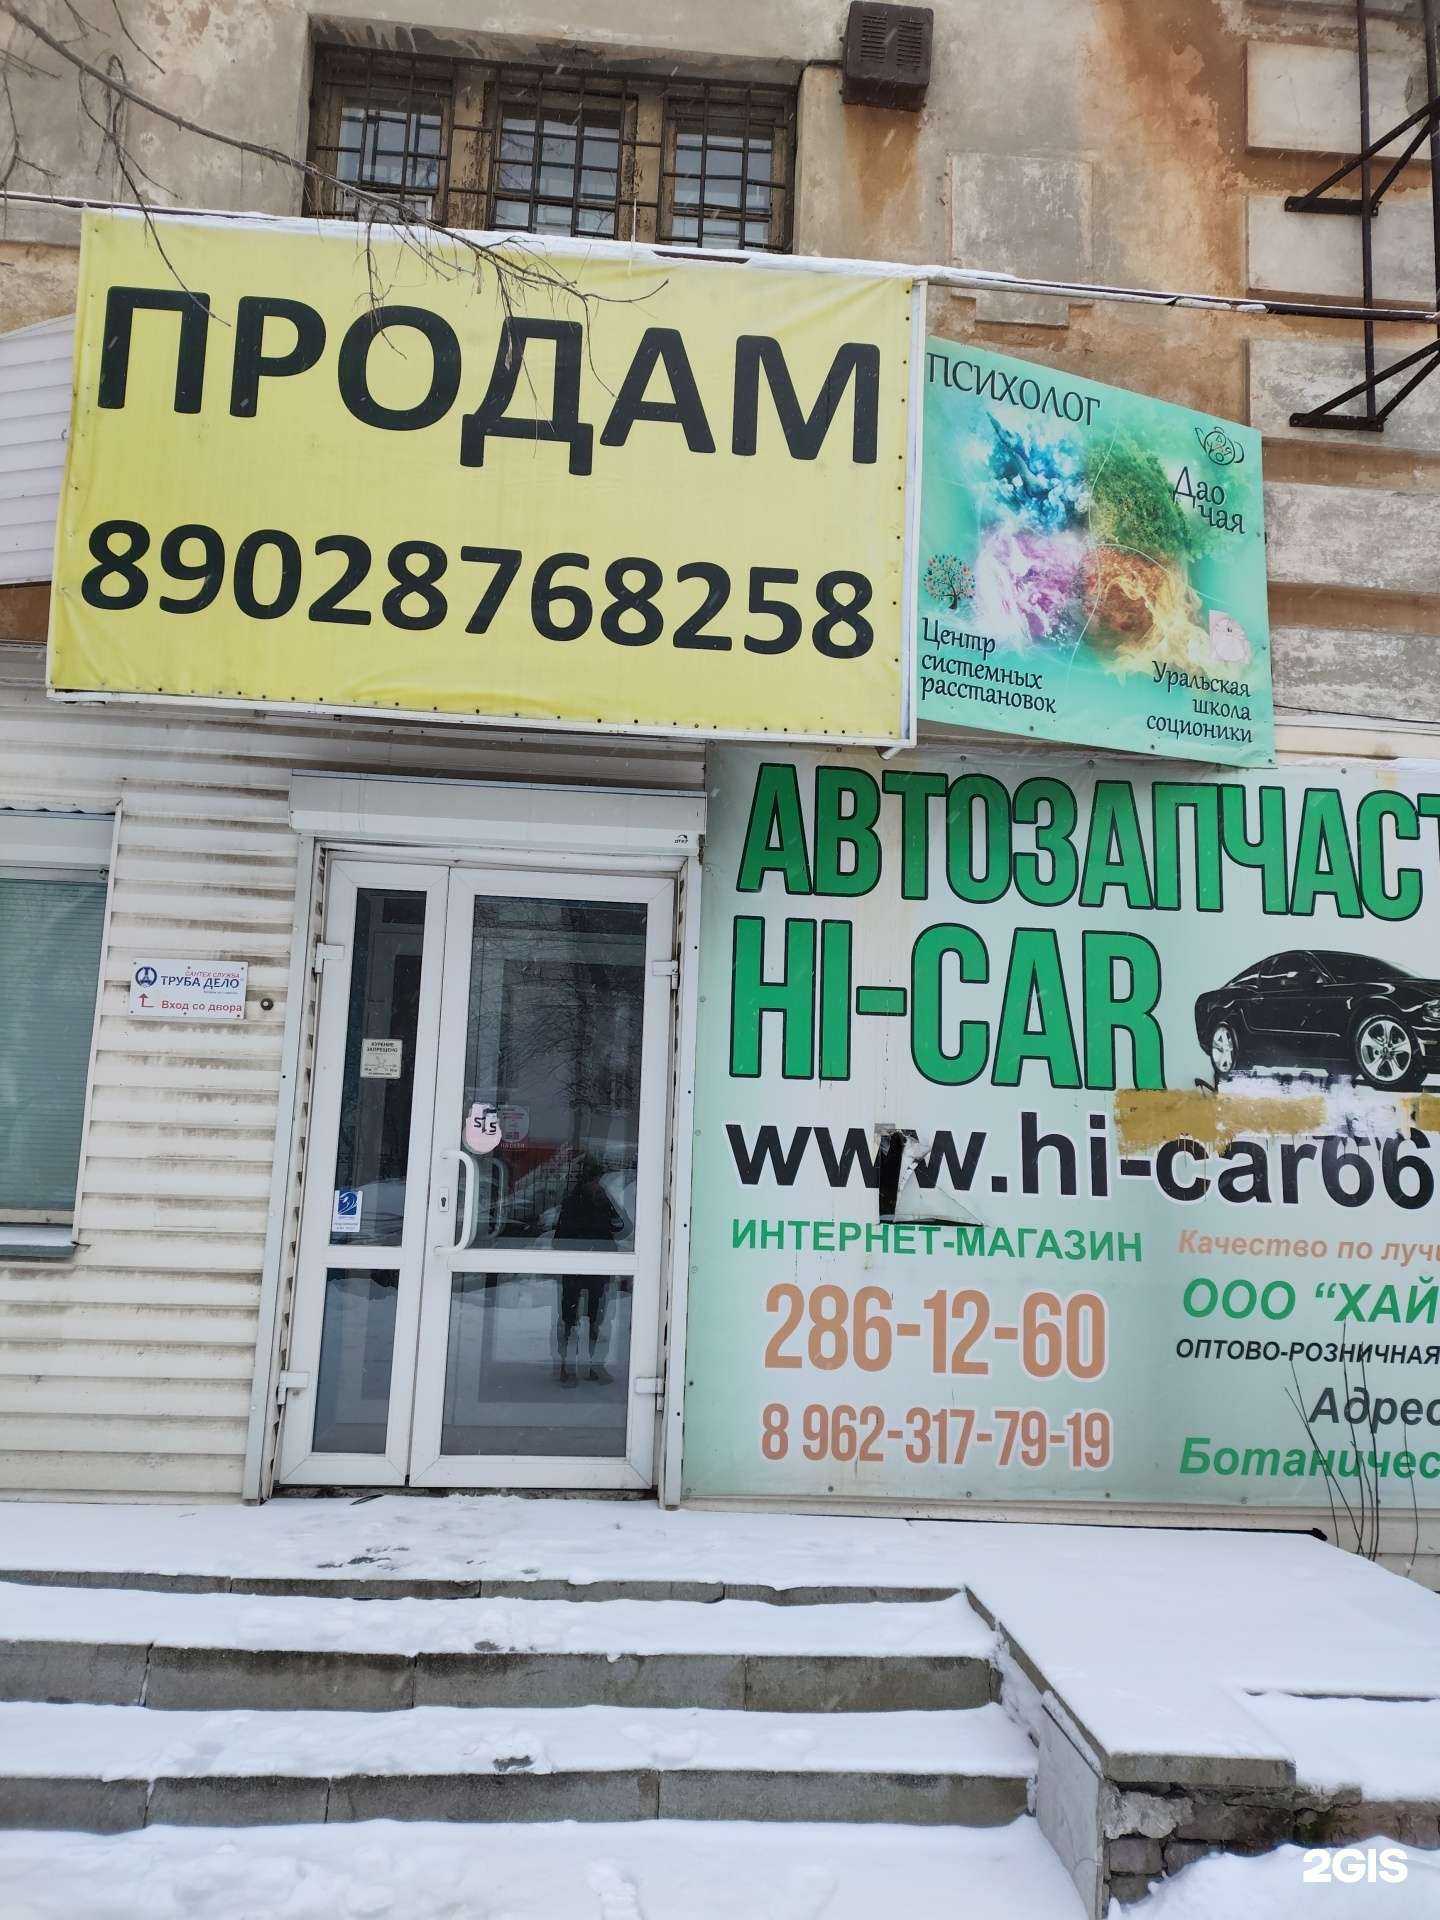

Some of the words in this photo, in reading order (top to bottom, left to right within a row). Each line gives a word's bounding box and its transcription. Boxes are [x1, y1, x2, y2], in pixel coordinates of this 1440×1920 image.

[97, 286, 880, 476] ПРОДАМ
[927, 352, 1100, 425] ПСИХОЛОГ
[1173, 465, 1225, 508] Дао
[1199, 504, 1247, 534] чая
[80, 519, 874, 659] 89028768258
[921, 617, 997, 661] Центр
[920, 675, 1057, 714] расстановок
[921, 656, 1043, 690] системных
[1151, 660, 1250, 698] Уральская
[1146, 715, 1253, 743] соционики
[1193, 698, 1252, 721] школа
[161, 975, 201, 987] ТРУБА
[203, 978, 240, 990] ДЕЛО
[728, 915, 1166, 1091] HI-CAR
[161, 1000, 189, 1011] Вход
[192, 1003, 206, 1011] со
[208, 1003, 242, 1013] двора
[731, 1218, 1143, 1263] ИНТЕРНЕТ-МАГАЗИН
[1178, 1229, 1328, 1259] Качество
[1337, 1240, 1373, 1260] по
[1380, 1240, 1440, 1267] луч
[1183, 1277, 1296, 1321] ООО
[764, 1282, 1107, 1379] 286-12-60
[1176, 1338, 1440, 1365] ОПТОВО-РОЗНИЧНАЯ
[761, 1402, 789, 1461] 8
[802, 1404, 1112, 1469] 962-317-79-19
[1179, 1436, 1440, 1479] Ботаничес
